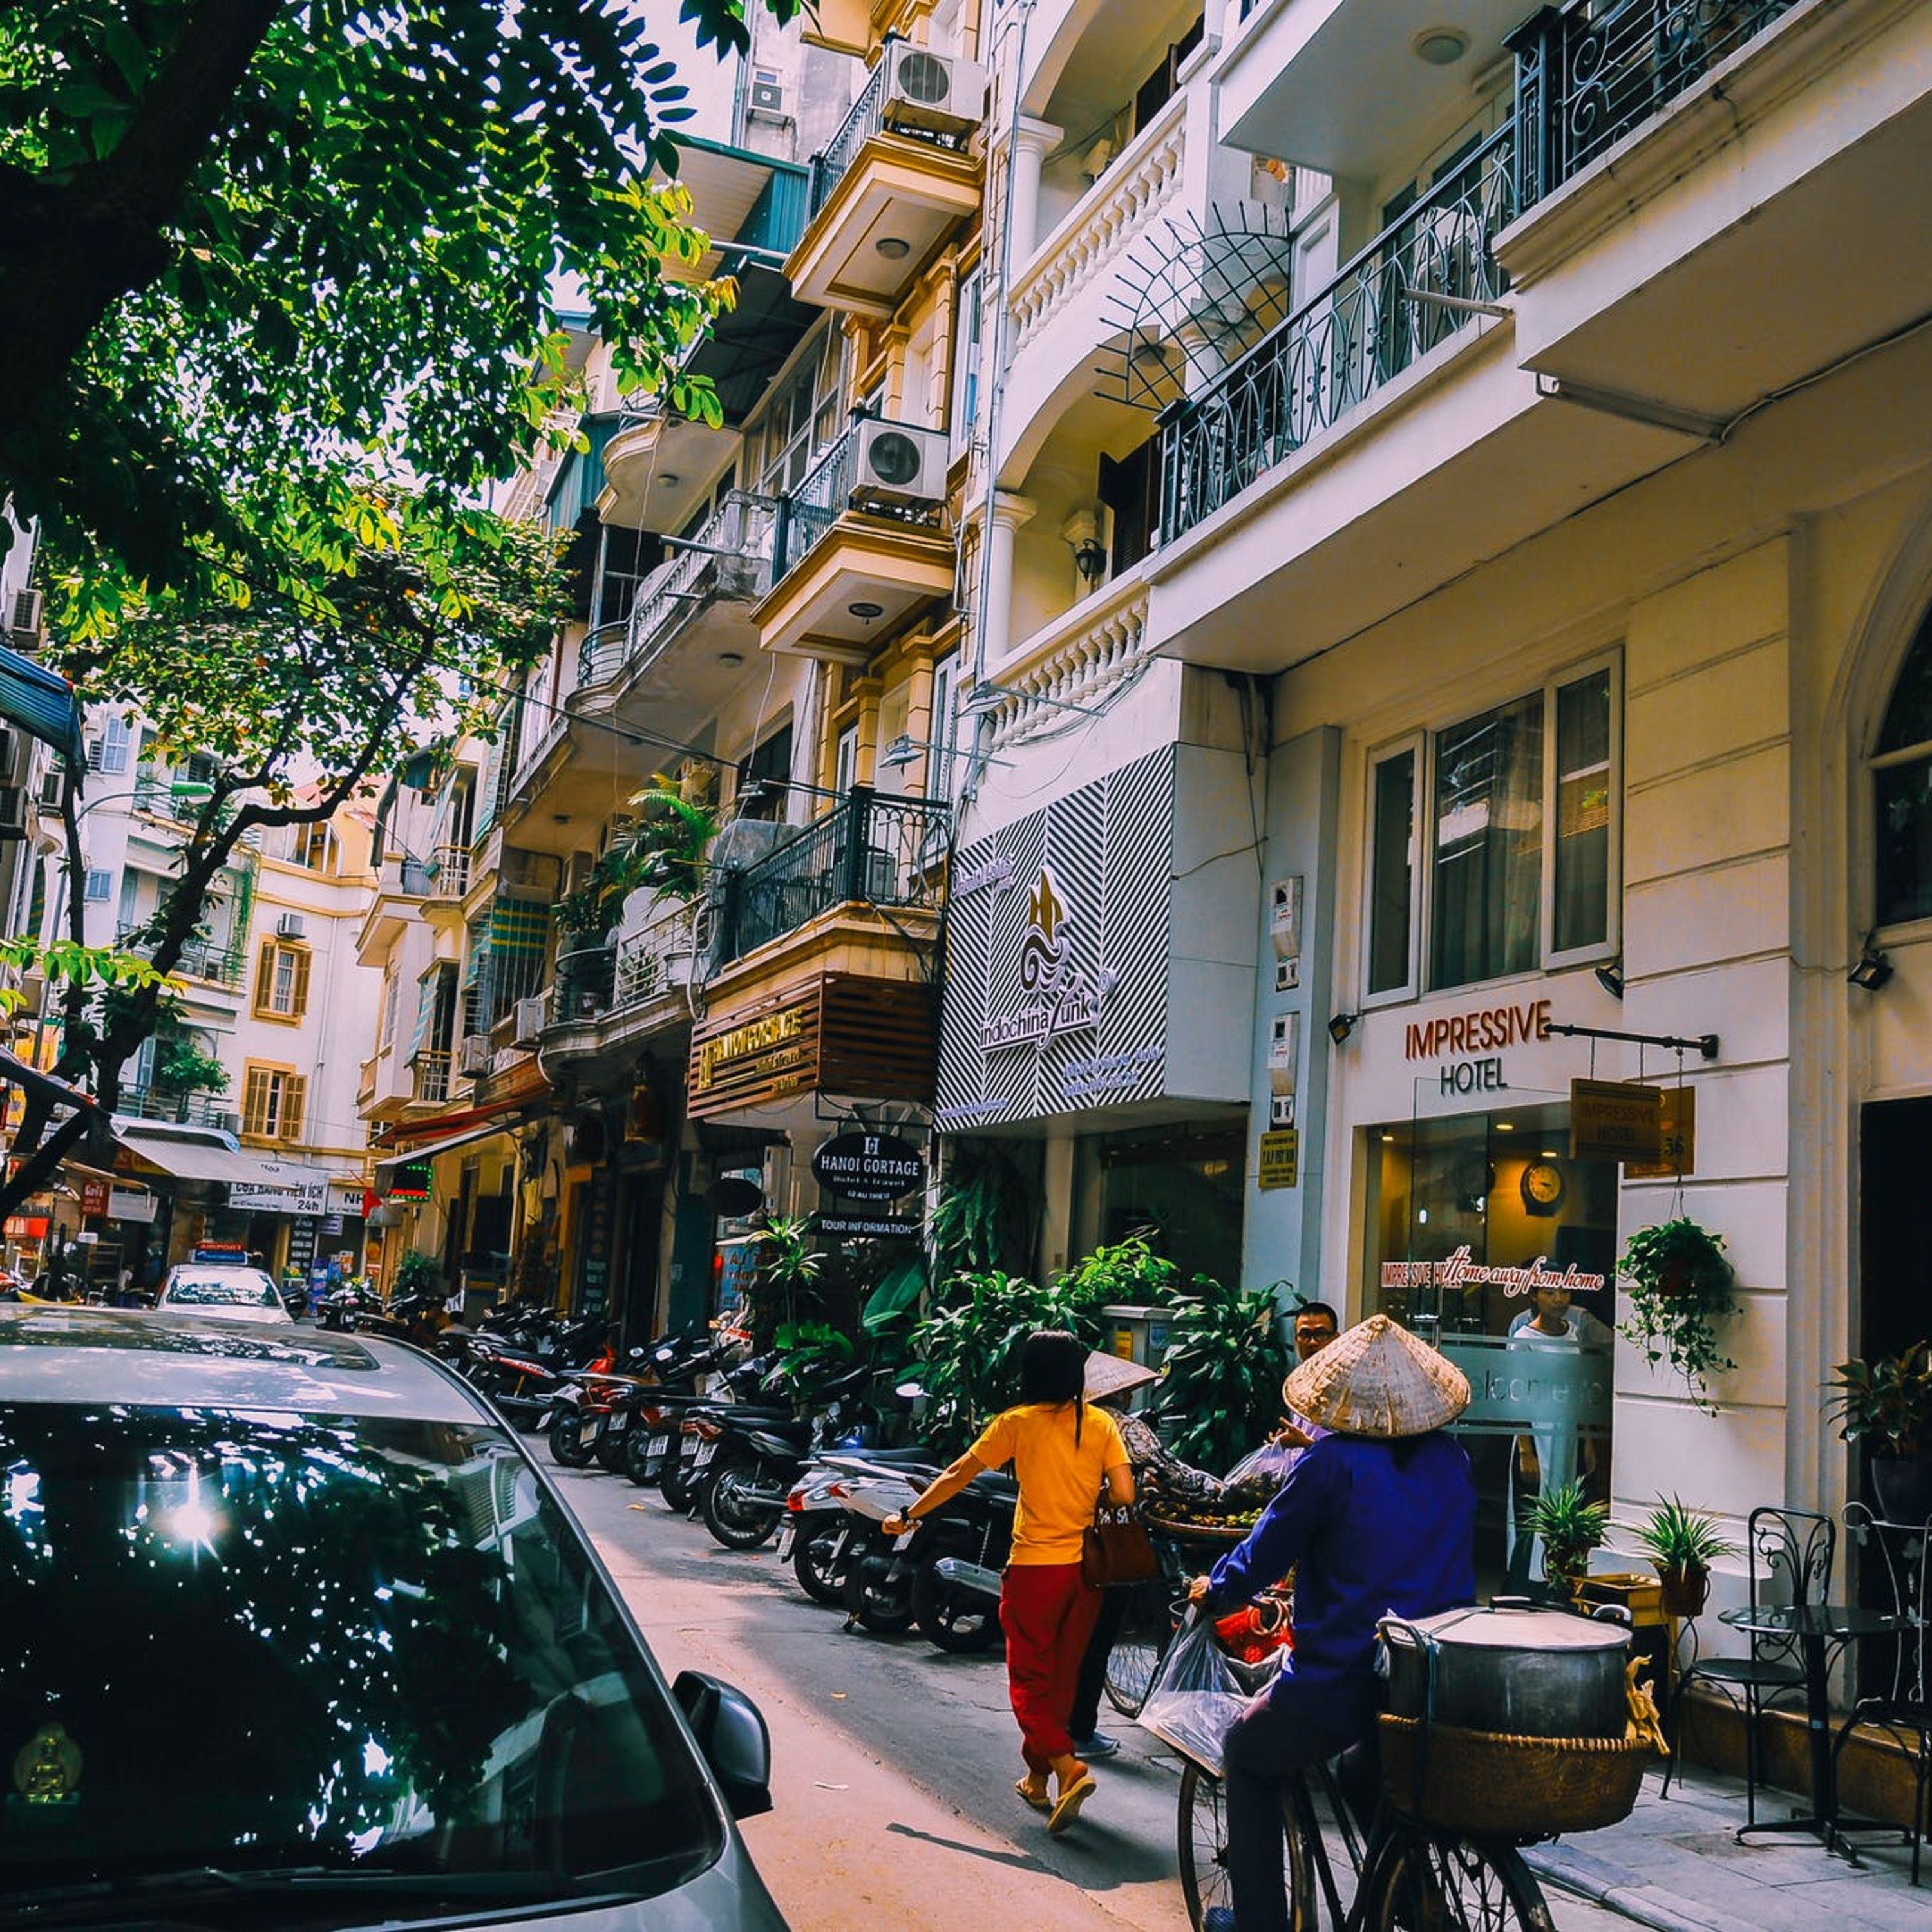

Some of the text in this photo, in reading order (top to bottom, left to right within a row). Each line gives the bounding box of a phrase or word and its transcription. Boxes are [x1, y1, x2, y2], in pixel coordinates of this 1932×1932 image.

[1405, 999, 1551, 1061] IMPRESSIVE
[1440, 1057, 1508, 1097] HOTEL
[821, 1155, 860, 1171] HANOI
[298, 1200, 319, 1211] 24h
[822, 1219, 911, 1235] TOUR INFORMATION
[1444, 1245, 1490, 1282] Home
[1489, 1263, 1524, 1298] away
[1522, 1255, 1562, 1294] from
[1561, 1262, 1605, 1290] home
